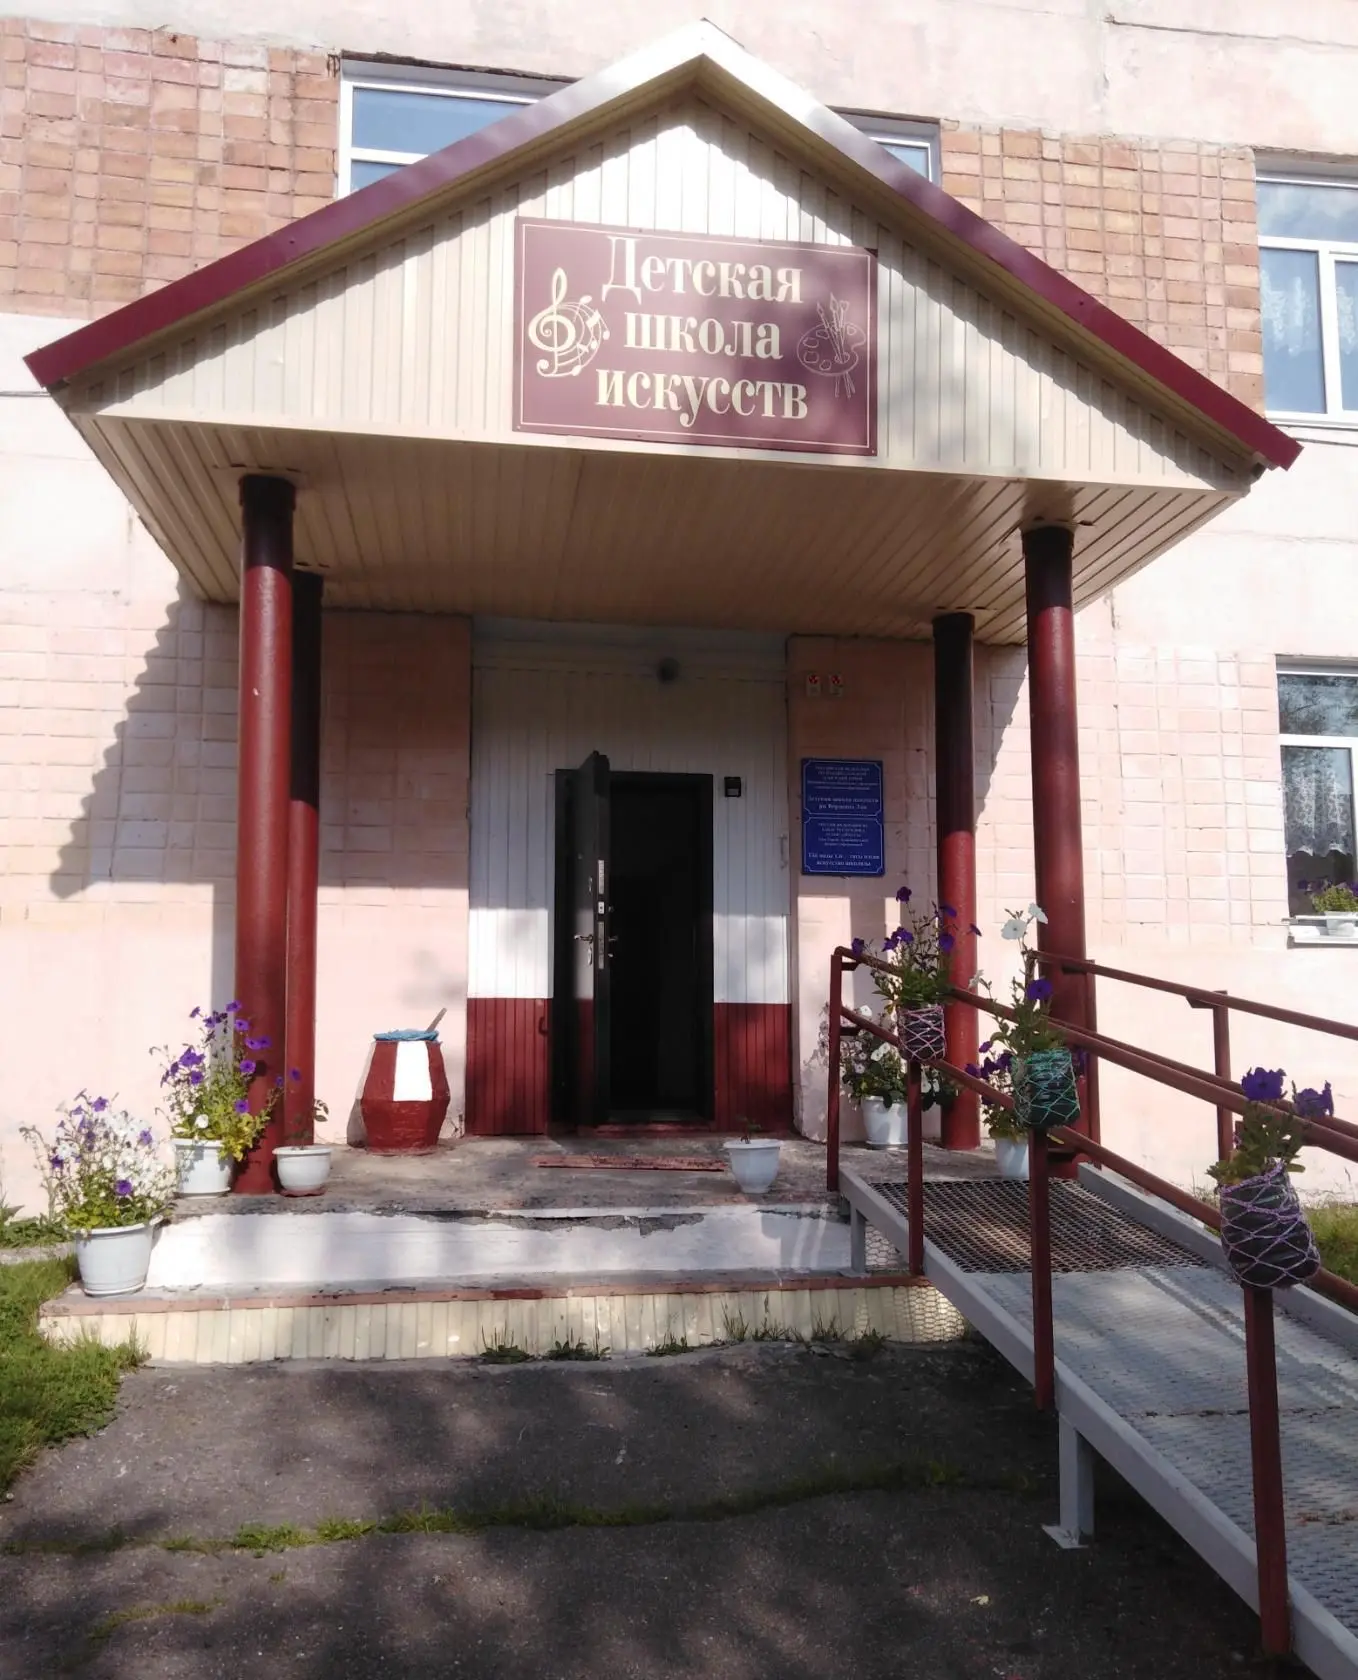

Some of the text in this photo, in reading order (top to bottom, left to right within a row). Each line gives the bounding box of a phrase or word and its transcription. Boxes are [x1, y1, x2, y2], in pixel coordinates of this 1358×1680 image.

[601, 235, 804, 304] Детская
[623, 311, 784, 360] школа
[595, 368, 809, 428] искусств
